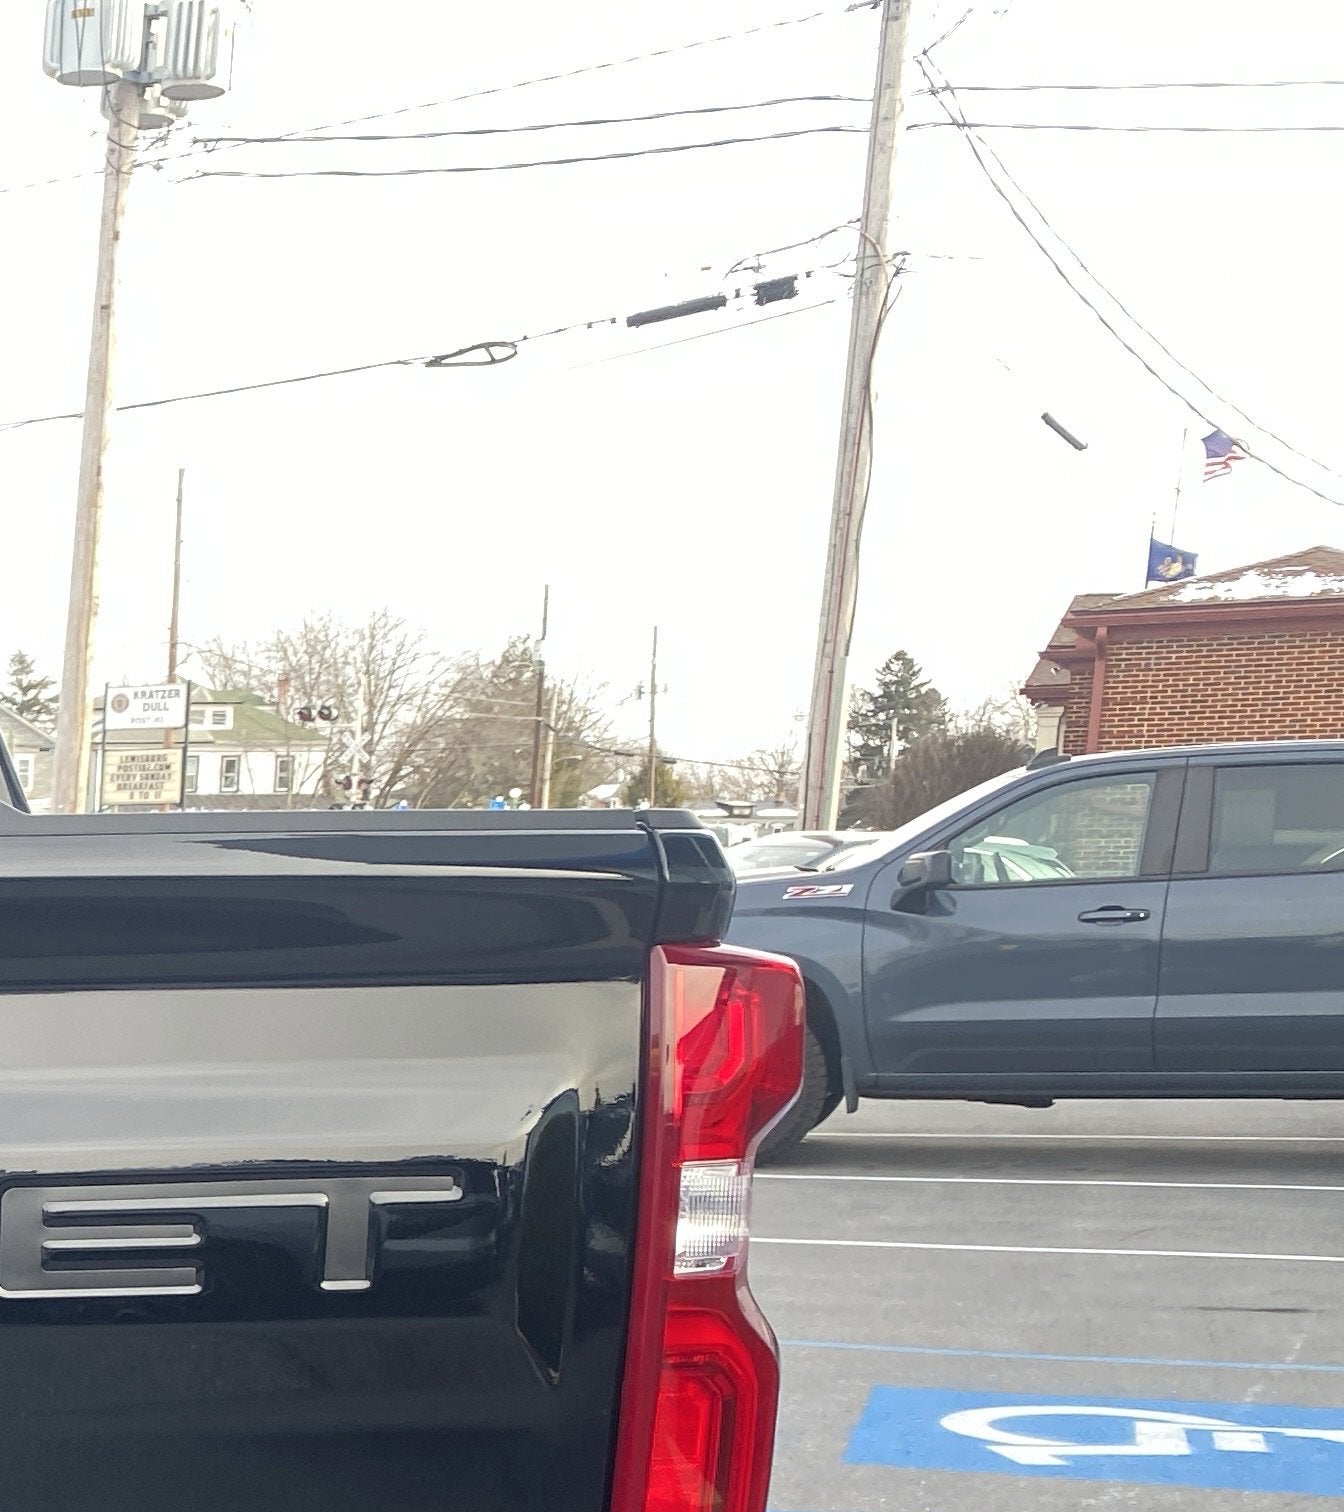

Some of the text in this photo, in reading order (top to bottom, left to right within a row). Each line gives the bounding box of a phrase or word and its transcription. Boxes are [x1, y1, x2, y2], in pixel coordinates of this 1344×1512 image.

[133, 689, 180, 700] KRATZER
[143, 702, 169, 712] DULL
[119, 754, 168, 763] LEWISBURG
[110, 772, 172, 782] EVERY SUNDAY
